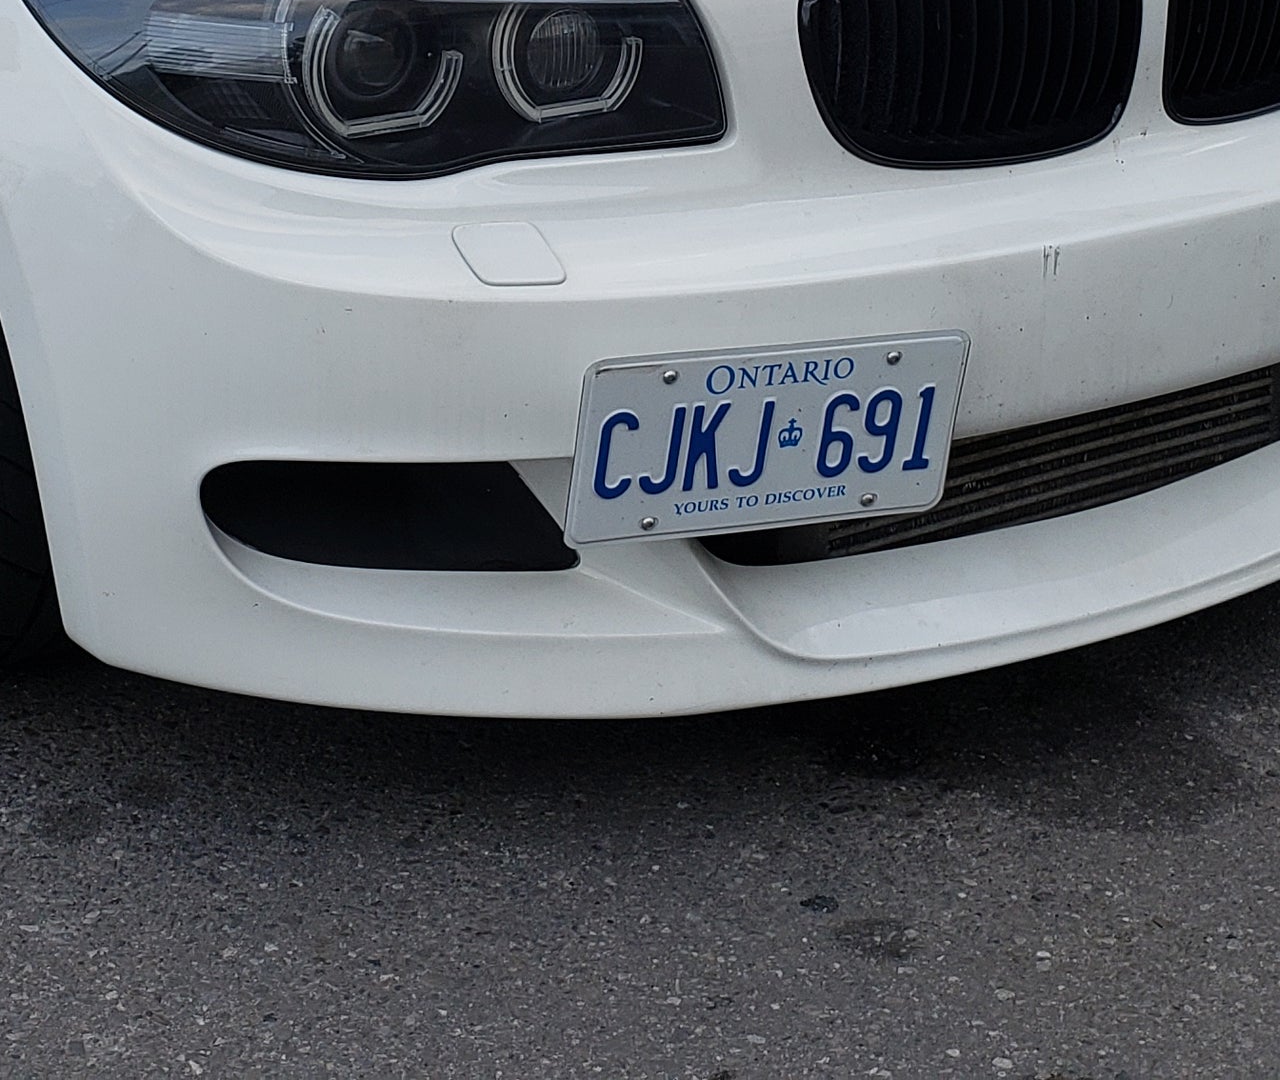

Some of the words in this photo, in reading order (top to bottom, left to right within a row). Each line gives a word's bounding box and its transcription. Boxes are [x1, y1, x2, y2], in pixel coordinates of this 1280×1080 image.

[705, 357, 855, 395] ONTARIO
[593, 400, 776, 500] CJKJ
[816, 386, 936, 478] 691
[674, 497, 729, 516] YOURS
[736, 495, 759, 509] TO
[764, 484, 847, 506] DISCOVER
